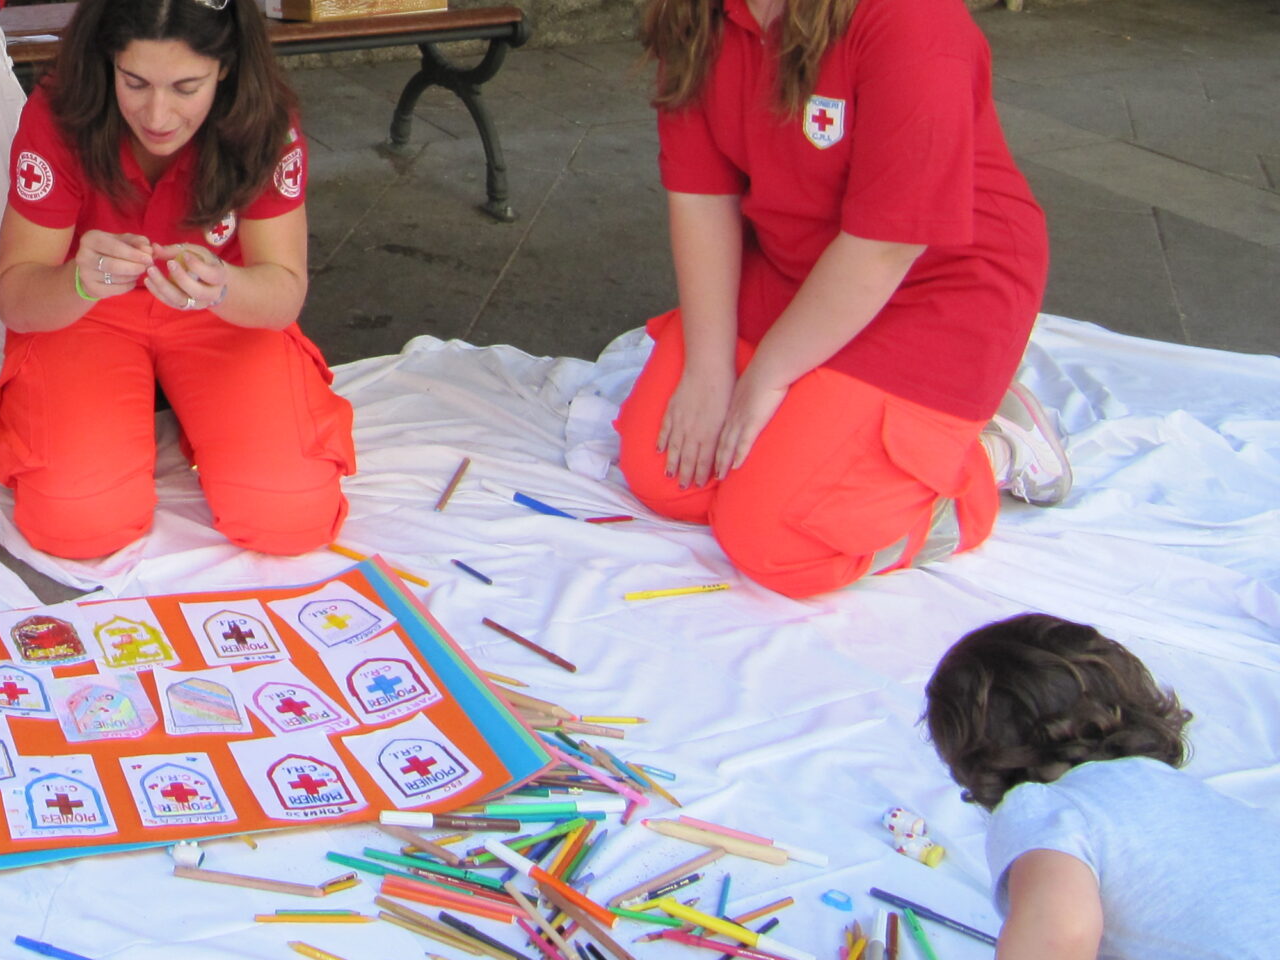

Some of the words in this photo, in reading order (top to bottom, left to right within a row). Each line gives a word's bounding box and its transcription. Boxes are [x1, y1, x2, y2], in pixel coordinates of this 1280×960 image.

[221, 642, 268, 653] PIONIERI
[367, 684, 417, 708] PIONIERI
[405, 765, 456, 791] PIONIERI
[289, 792, 343, 805] PIONIERI
[41, 813, 96, 824] PIONIERI
